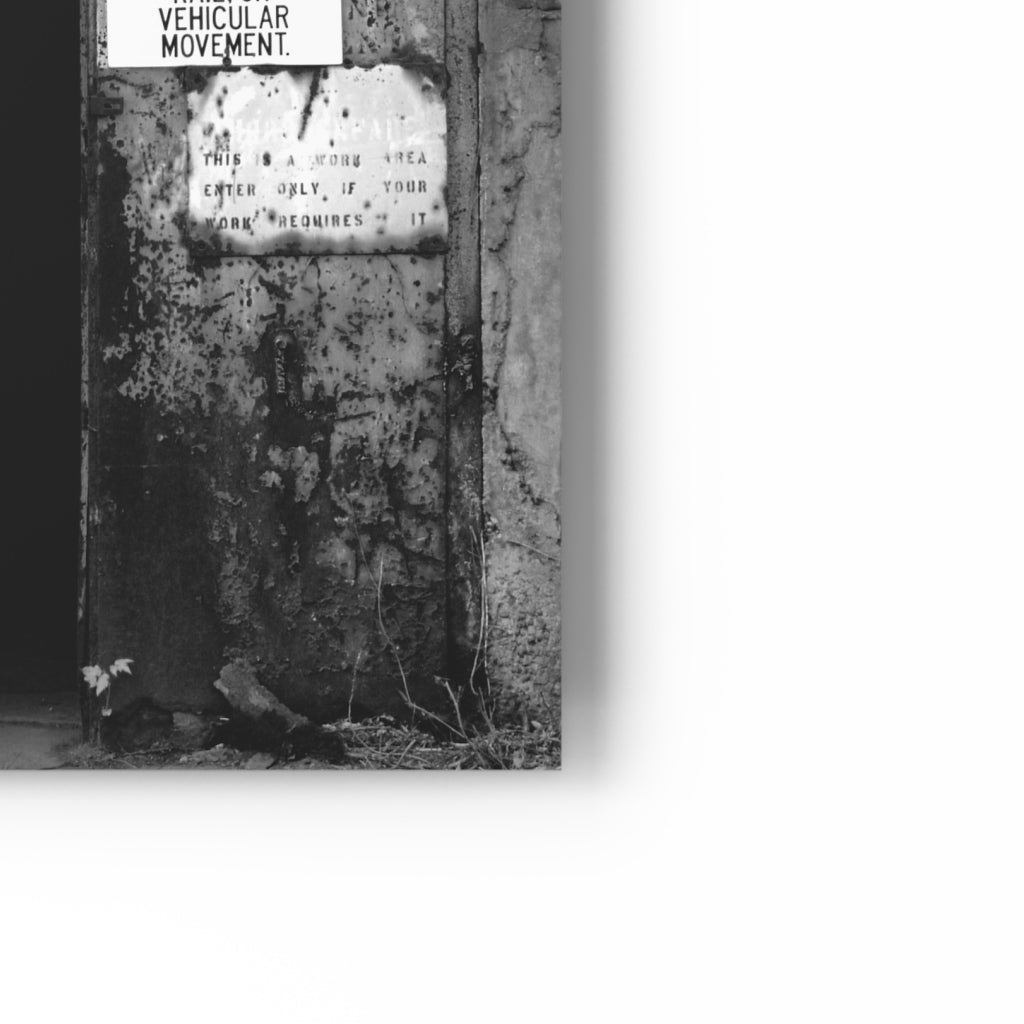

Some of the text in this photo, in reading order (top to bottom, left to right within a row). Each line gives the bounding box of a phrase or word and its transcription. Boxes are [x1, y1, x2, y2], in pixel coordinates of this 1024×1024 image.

[158, 5, 290, 32] VEHICULAR
[161, 32, 291, 59] MOVEMENT.
[203, 152, 242, 167] THIS
[286, 154, 296, 167] A
[312, 152, 362, 168] WORK
[203, 180, 428, 198] ENTER ONLY IF YOUR
[204, 211, 428, 231] WORK REQUIRES IT
